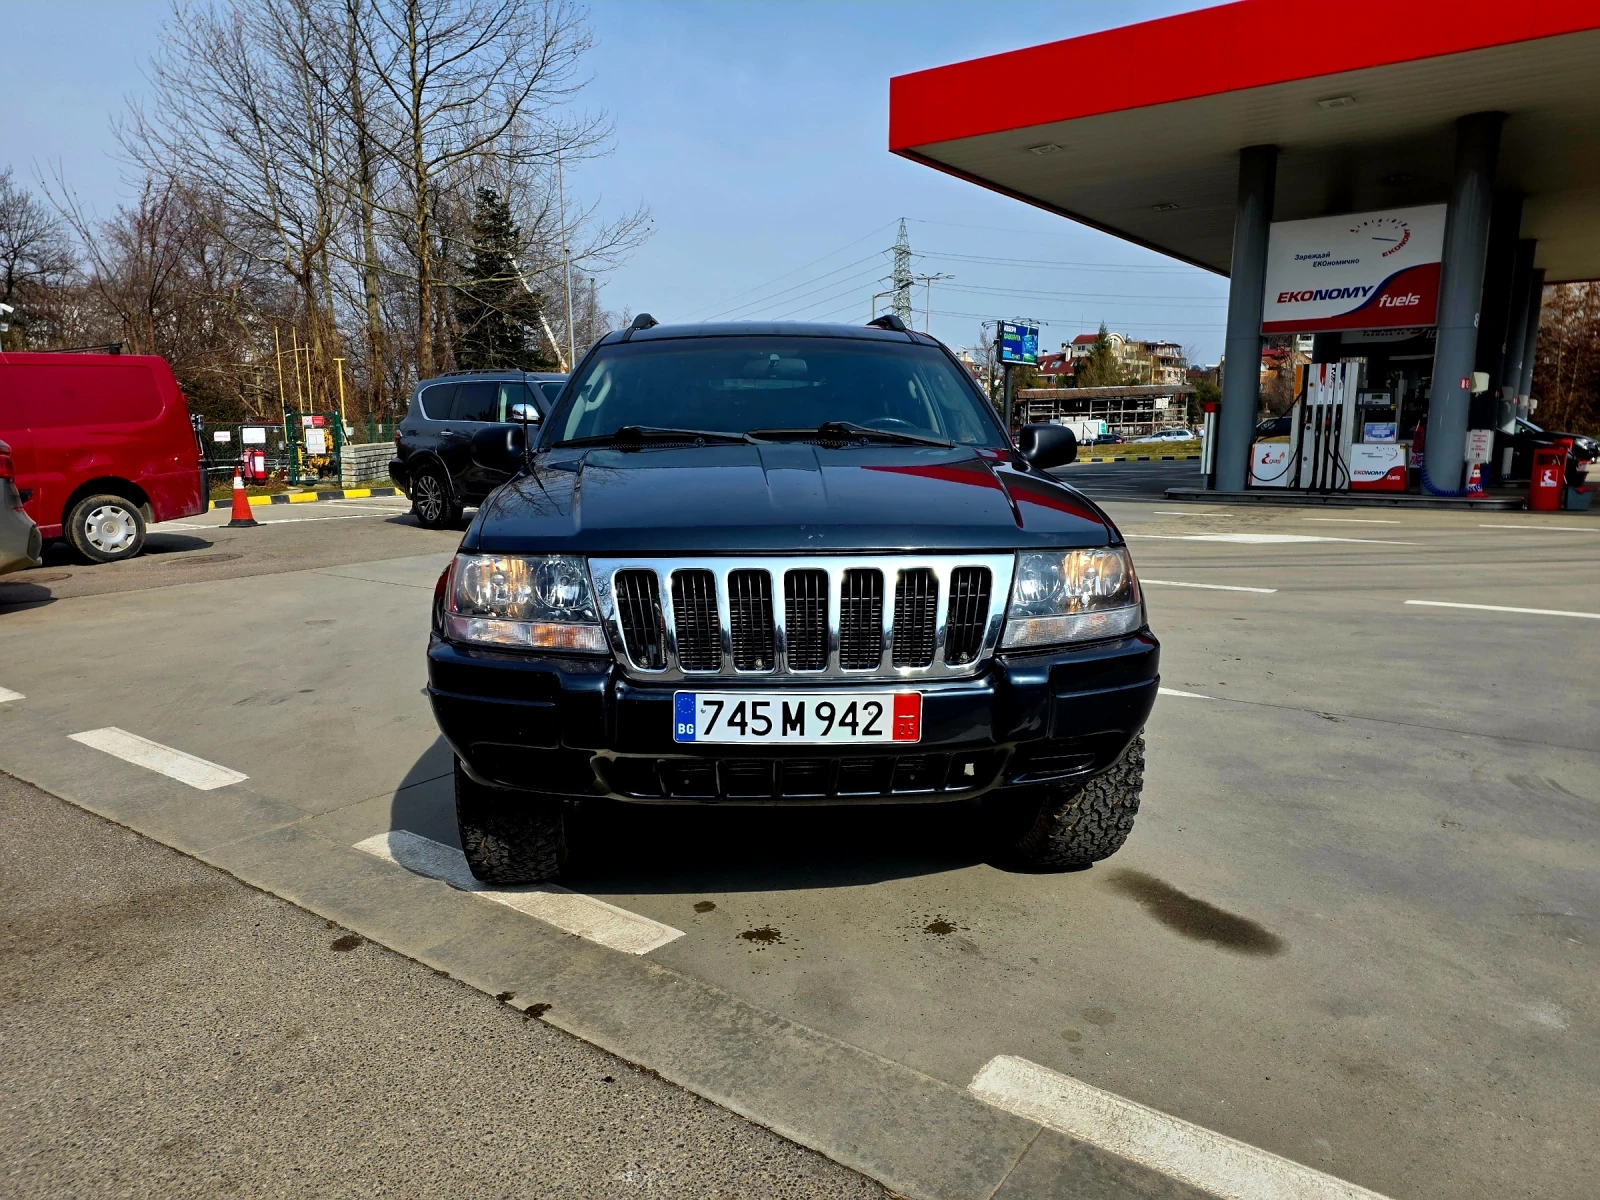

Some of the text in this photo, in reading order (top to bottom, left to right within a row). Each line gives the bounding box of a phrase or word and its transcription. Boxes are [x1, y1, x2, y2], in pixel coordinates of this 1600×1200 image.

[1382, 229, 1410, 257] EKONOMY
[1295, 251, 1330, 260] Зареждай
[1277, 285, 1420, 307] EKONOMY fuels
[678, 723, 694, 734] BG
[703, 700, 883, 736] 745 M 942
